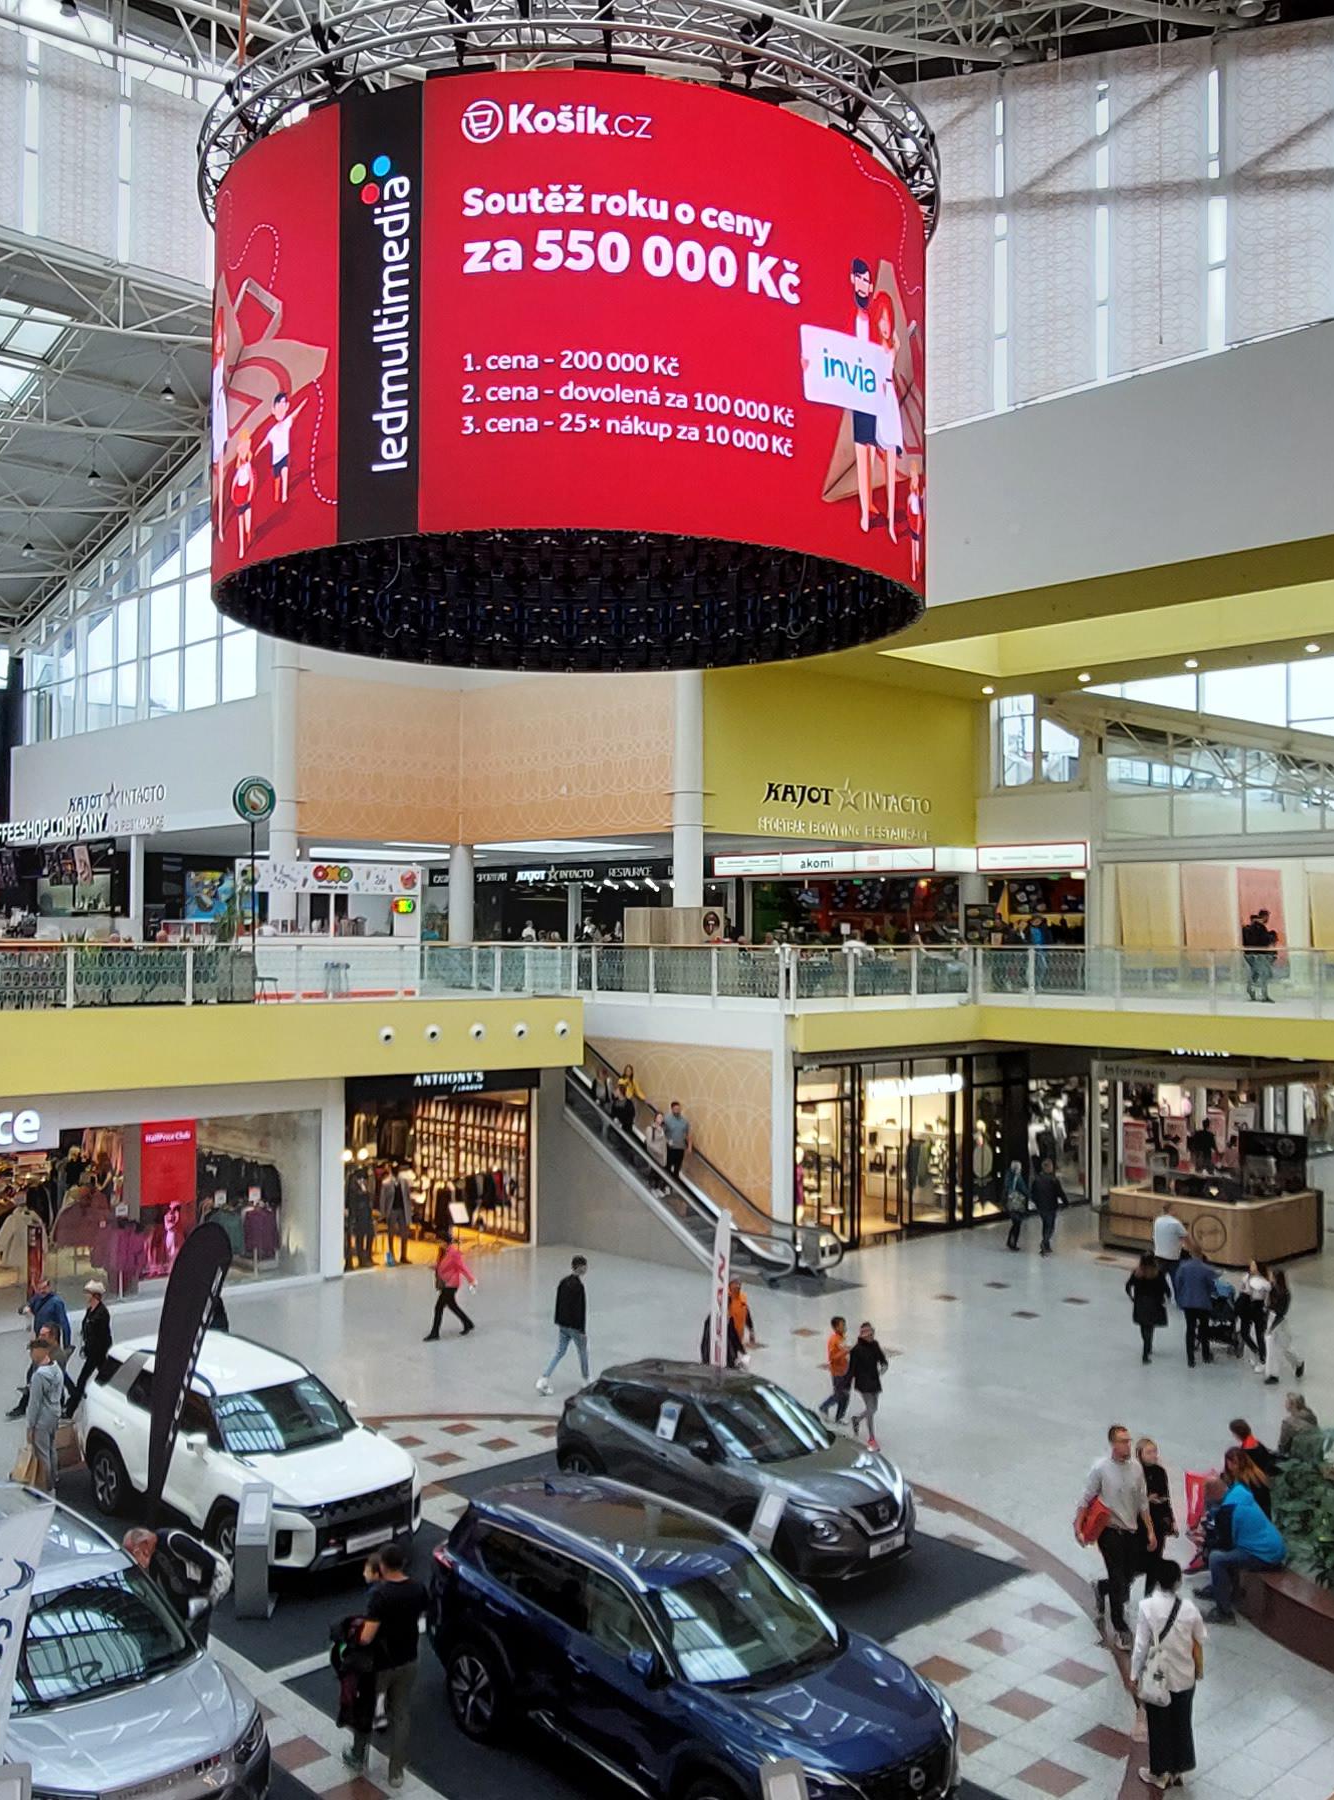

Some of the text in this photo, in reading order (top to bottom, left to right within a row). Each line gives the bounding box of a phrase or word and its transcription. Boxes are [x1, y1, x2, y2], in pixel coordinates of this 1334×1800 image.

[508, 103, 652, 139] Košík.cz
[462, 184, 772, 246] Soutěž roku o ceny
[462, 229, 802, 305] za 550 000 Kč
[371, 175, 411, 473] ledmultimedia
[463, 352, 481, 371] 1.
[485, 354, 539, 371] cena
[559, 351, 604, 371] 200
[607, 353, 650, 373] 000
[653, 356, 680, 377] Kč
[822, 347, 876, 394] invia
[462, 384, 481, 403] 2.
[485, 385, 539, 401] cena
[559, 382, 661, 407] dovolená
[665, 391, 688, 409] za
[693, 392, 731, 414] 100
[733, 400, 770, 422] 000
[773, 405, 795, 428] Kč
[461, 416, 481, 435] 3.
[485, 417, 539, 433] cena
[606, 415, 672, 442] nákup
[676, 424, 700, 441] za
[705, 425, 730, 445] 10
[732, 430, 769, 452] 000
[771, 435, 794, 458] Kč
[67, 784, 165, 814] KAJOT INTACTO
[762, 782, 932, 815] KAJOT INTACTO
[49, 812, 107, 839] COMPANY
[809, 820, 859, 837] BOWLING
[799, 857, 835, 869] akomi
[413, 1071, 485, 1087] ANTHONY'S
